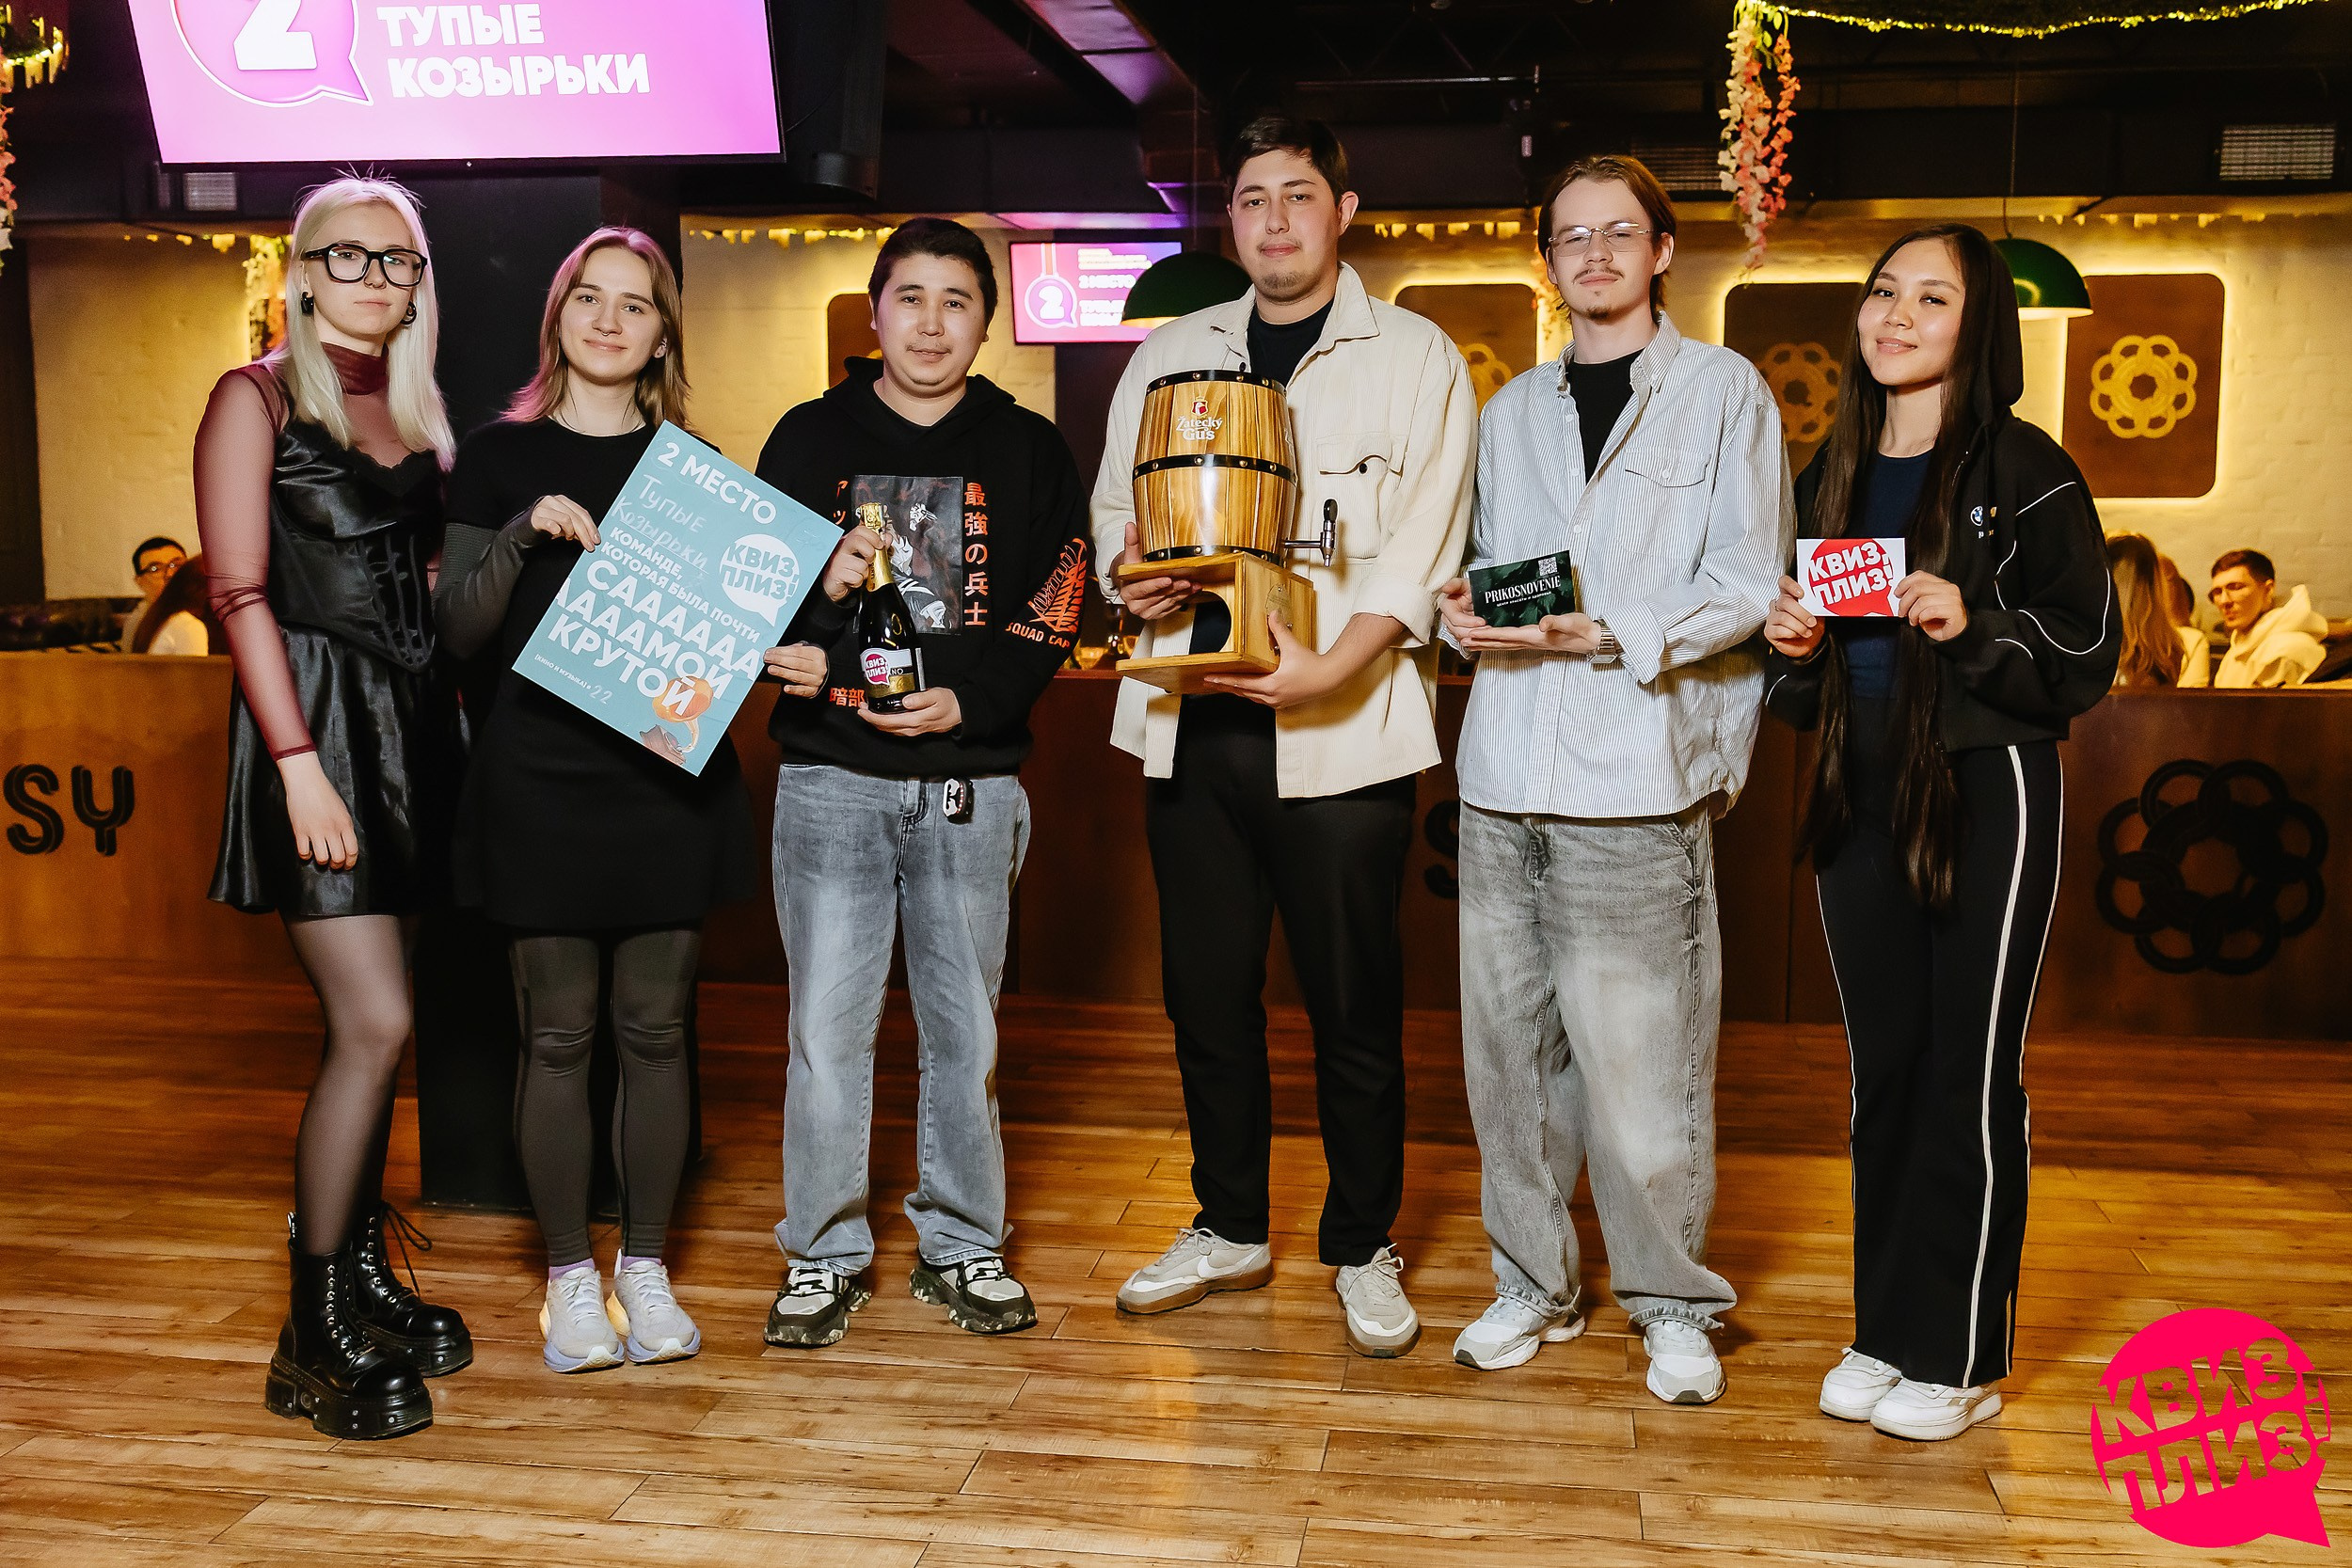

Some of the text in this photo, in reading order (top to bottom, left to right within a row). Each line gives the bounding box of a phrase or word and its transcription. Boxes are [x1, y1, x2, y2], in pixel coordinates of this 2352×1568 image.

[376, 4, 545, 47] ТУПЫЕ
[387, 53, 650, 98] КОЗЫРЬКИ
[1176, 416, 1223, 432] Žatecký
[1183, 427, 1216, 441] Gus
[658, 442, 777, 525] 2 МЕСТО
[610, 527, 683, 581] КОМАНДЕ,
[964, 482, 989, 626] 最強の兵士
[600, 541, 761, 643] КОТОРАЯ БЫЛА ПОЧТИ
[721, 564, 796, 602] ПЛИЗ!
[1485, 575, 1562, 604] PRIKOSNOVENIE
[1812, 564, 1895, 606] ПЛИЗ!
[1005, 622, 1044, 642] SQUAD
[548, 613, 696, 716] КРУТОЙ
